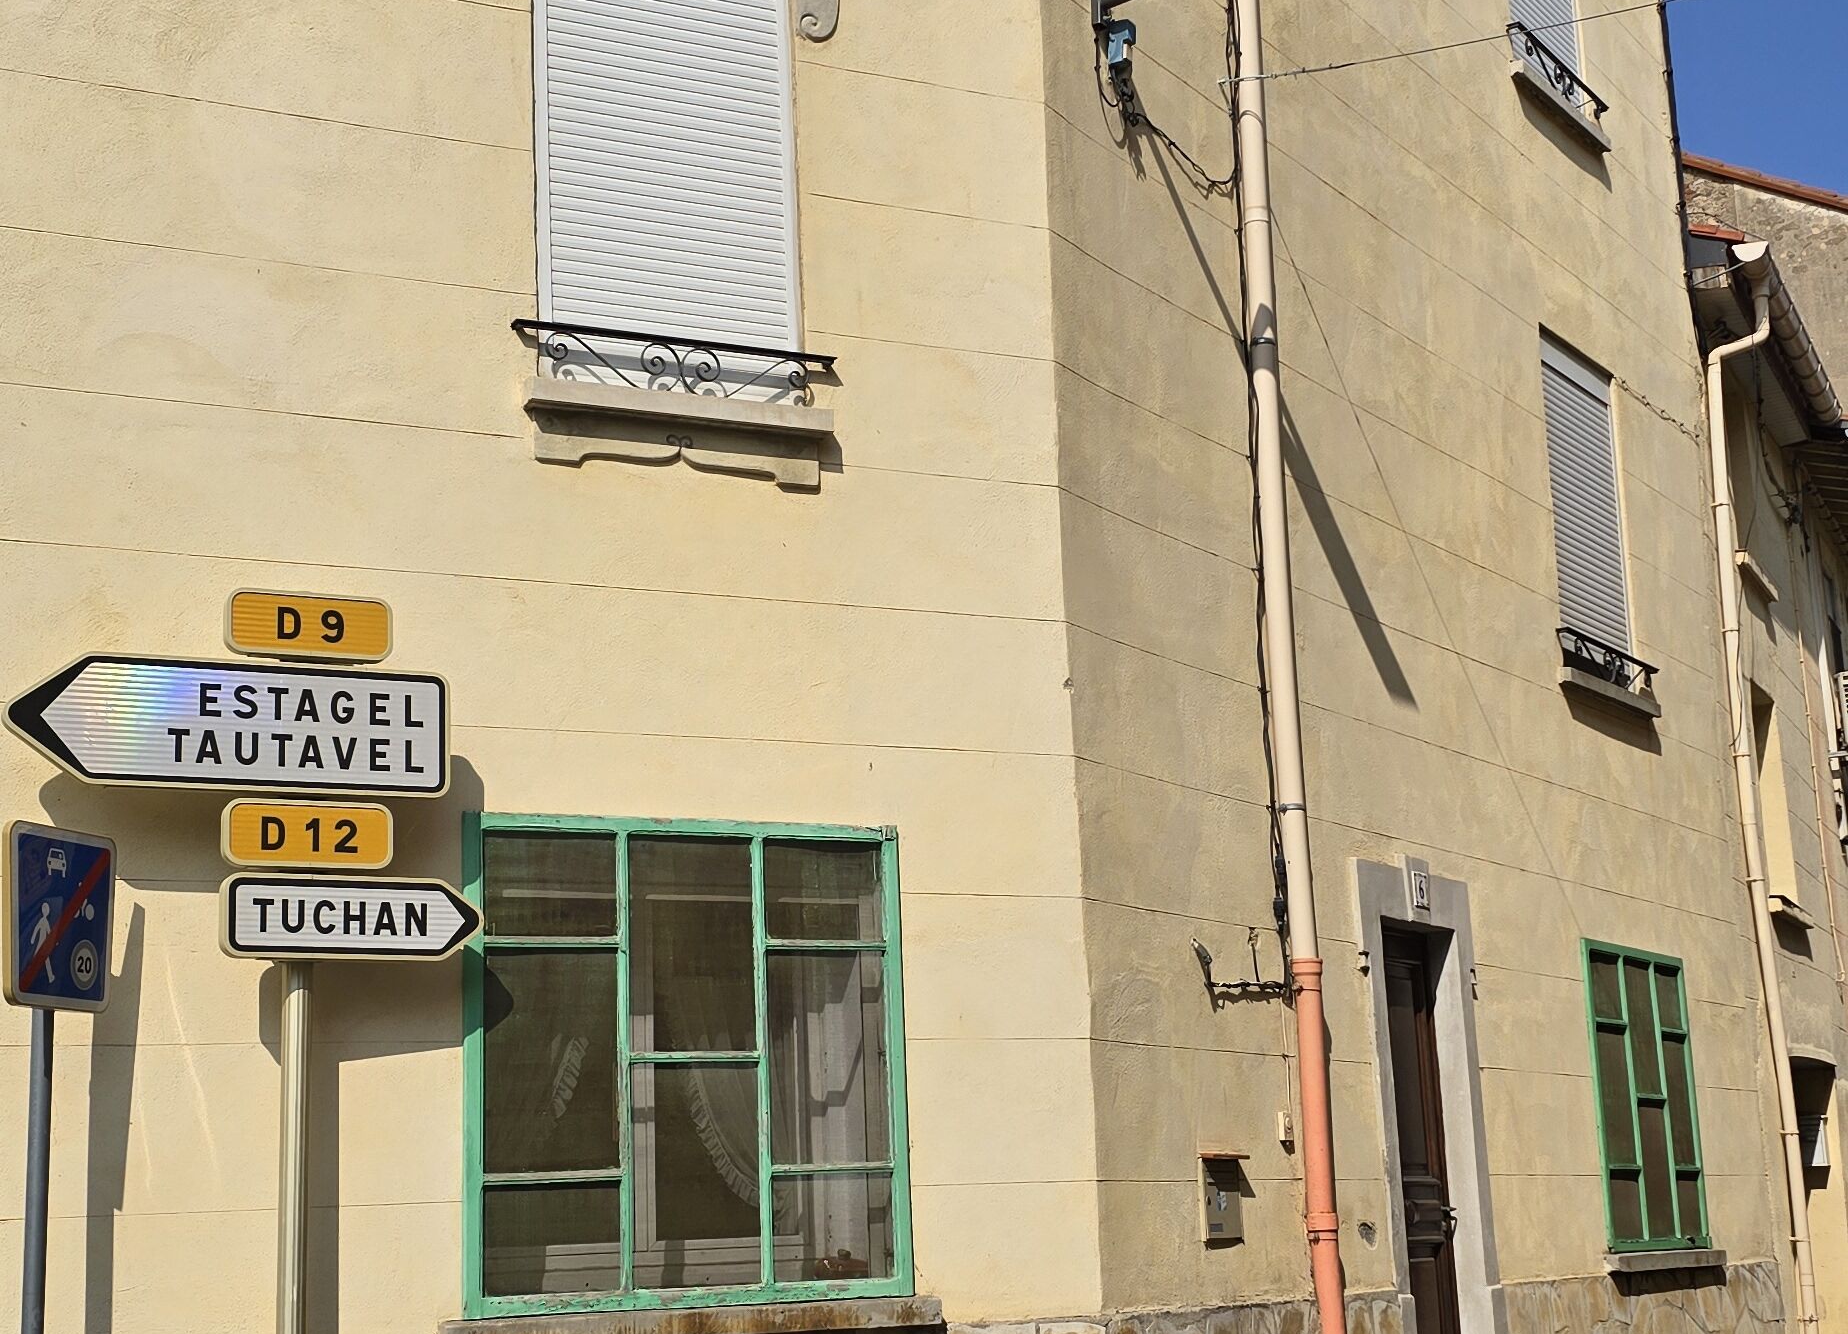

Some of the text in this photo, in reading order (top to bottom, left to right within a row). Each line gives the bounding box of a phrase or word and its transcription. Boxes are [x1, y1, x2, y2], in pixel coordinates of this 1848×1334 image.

[276, 606, 345, 643] D 9
[199, 683, 424, 728] ESTAGEL
[167, 728, 424, 773] TAUTAVEL
[260, 816, 358, 853] D 12
[1418, 879, 1425, 900] 6
[252, 897, 428, 937] TUCHAN
[77, 956, 92, 974] 20
